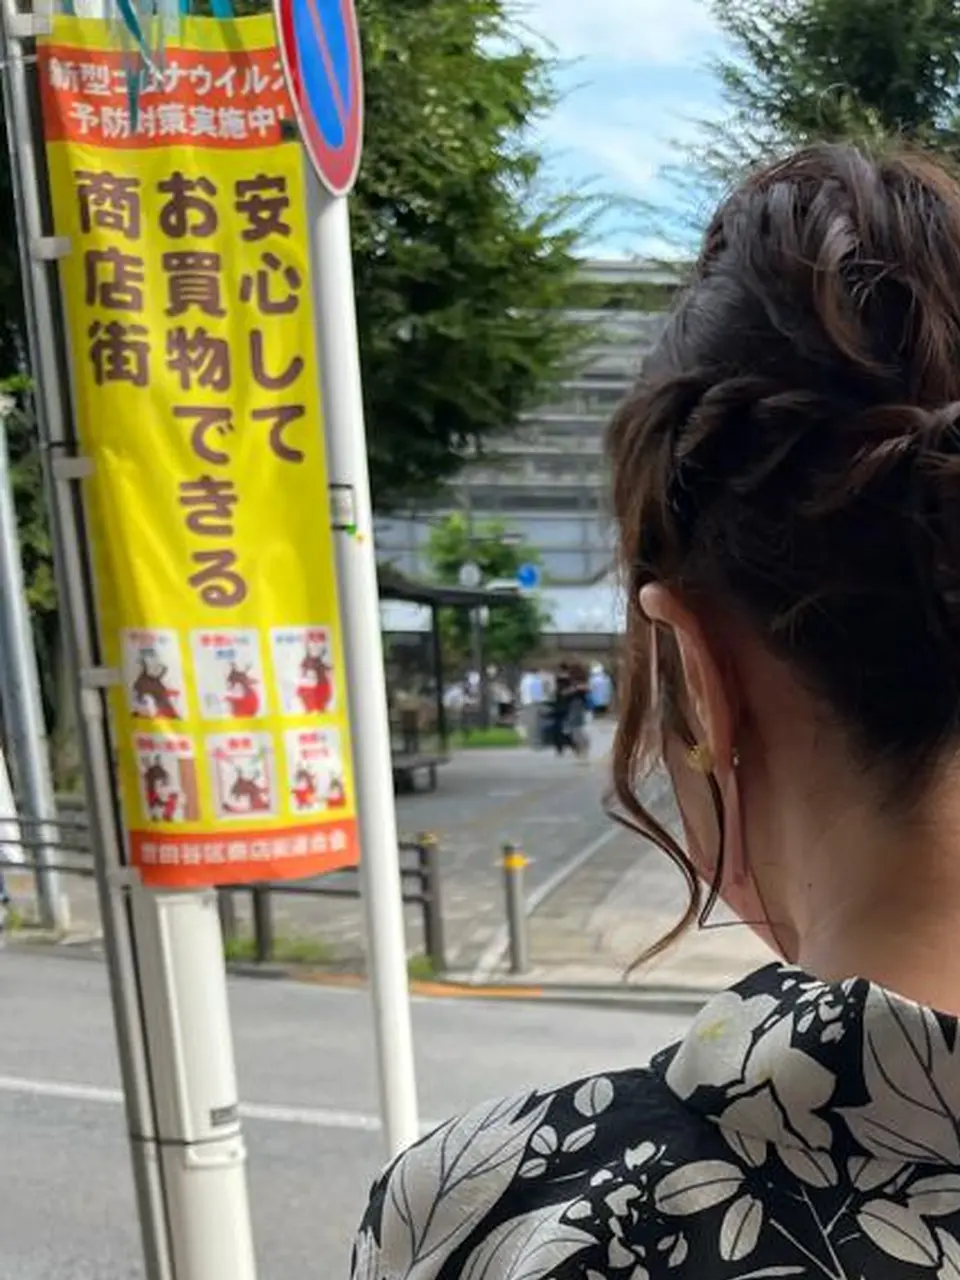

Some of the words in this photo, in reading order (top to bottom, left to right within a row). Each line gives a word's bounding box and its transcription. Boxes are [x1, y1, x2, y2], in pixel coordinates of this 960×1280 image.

[73, 170, 151, 389] 商店街
[156, 171, 248, 608] お買物できる
[234, 174, 305, 464] 安心して
